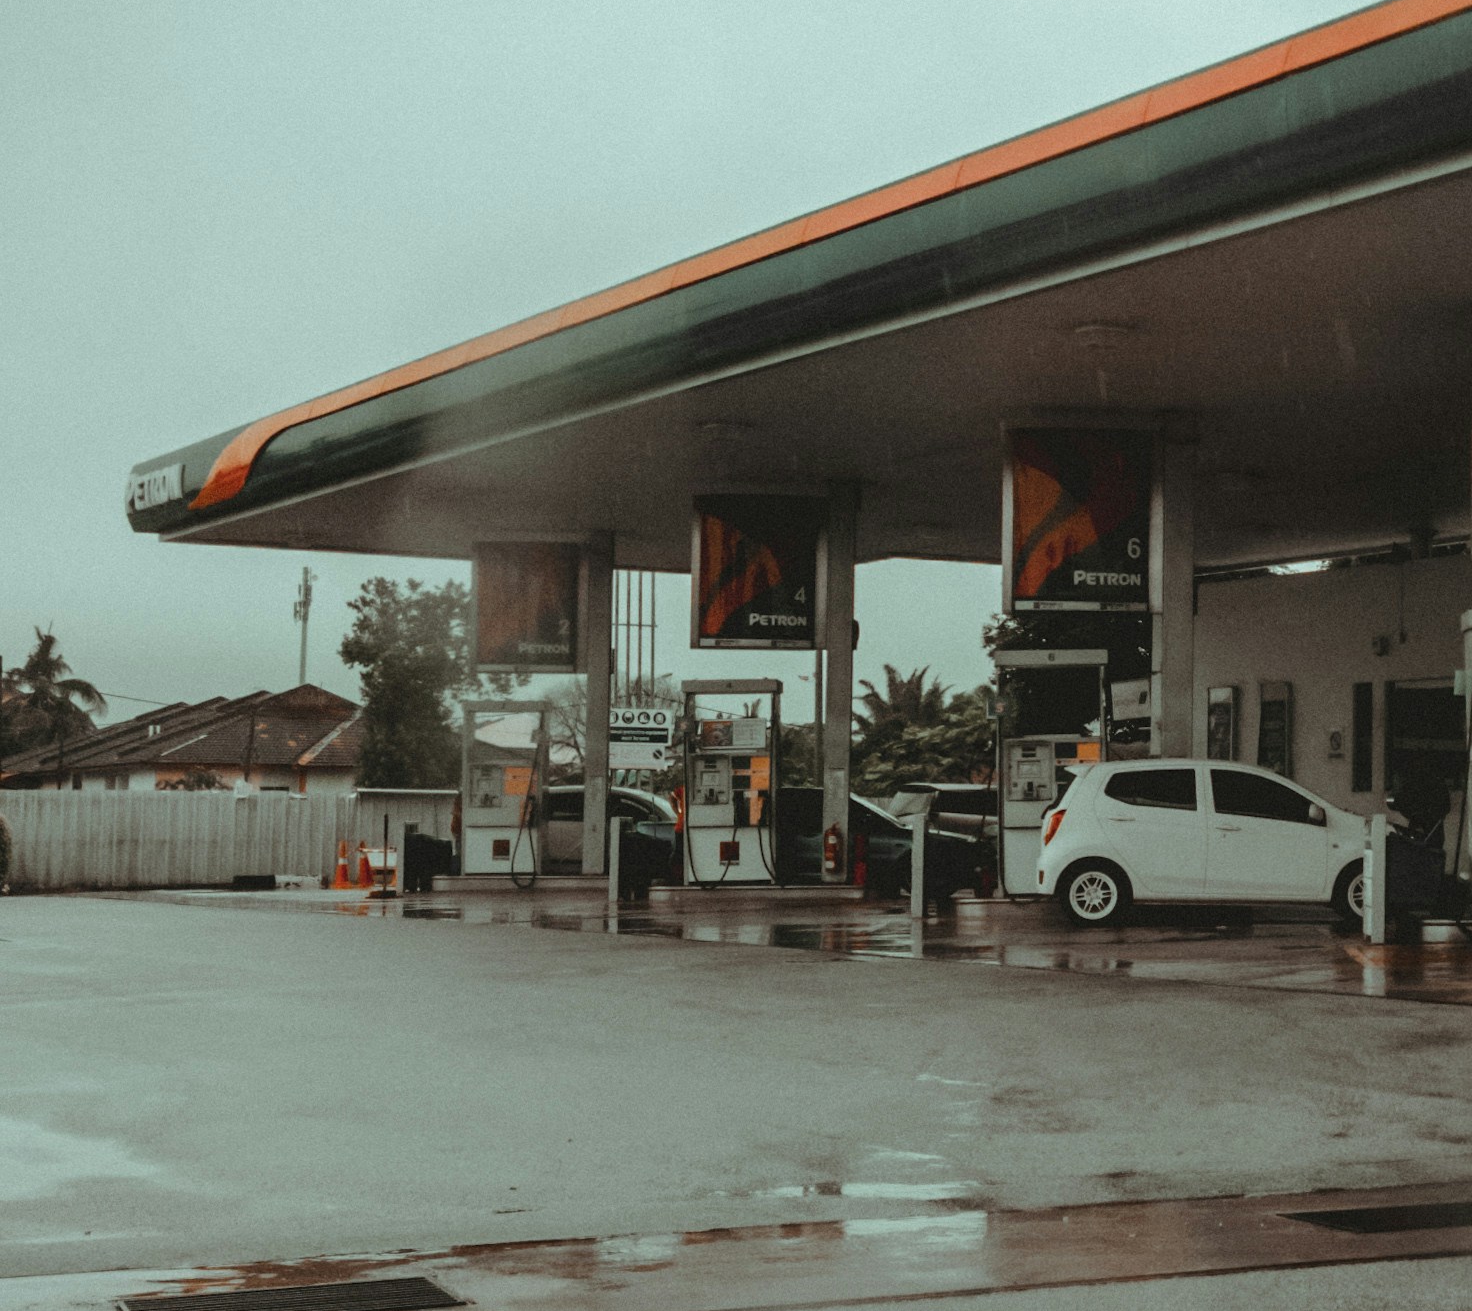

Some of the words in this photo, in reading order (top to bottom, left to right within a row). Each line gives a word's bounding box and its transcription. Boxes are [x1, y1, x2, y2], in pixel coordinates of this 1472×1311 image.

[1127, 537, 1141, 559] 6
[1073, 570, 1141, 586] PETRON
[794, 586, 806, 604] 4
[749, 612, 808, 627] PETRON
[519, 642, 571, 655] PETRON
